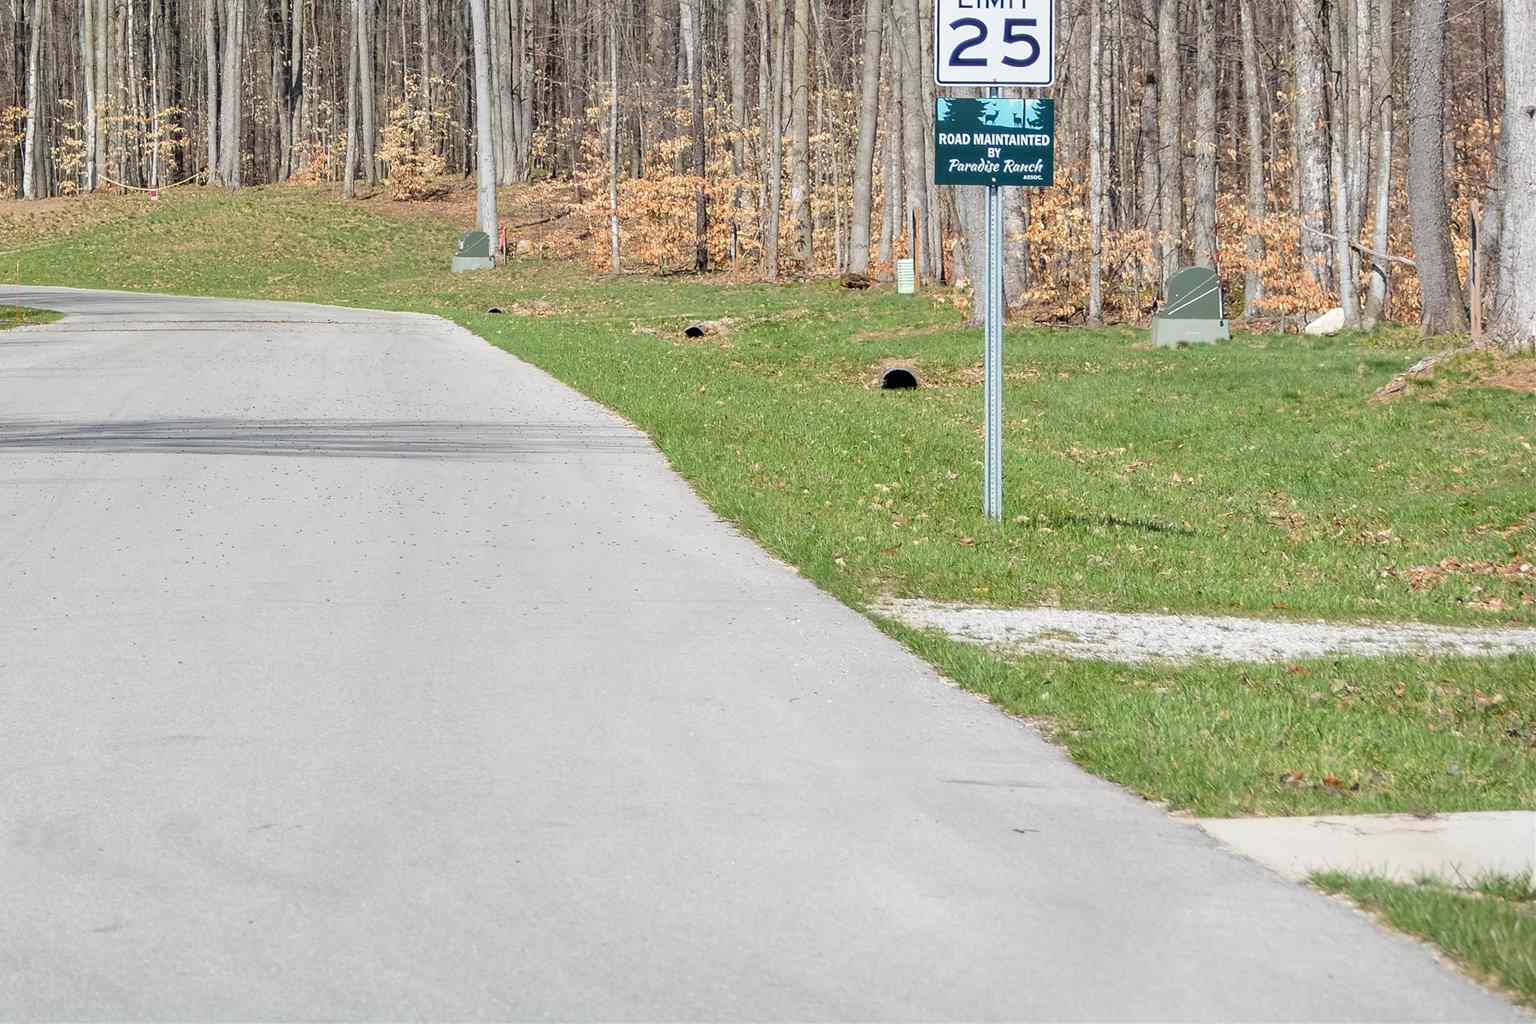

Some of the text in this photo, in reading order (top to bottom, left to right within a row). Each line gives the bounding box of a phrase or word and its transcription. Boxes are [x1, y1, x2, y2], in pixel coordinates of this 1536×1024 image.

[948, 17, 1041, 68] 25
[938, 133, 1051, 146] ROAD MAINTAINTED
[987, 148, 1002, 158] BY
[948, 158, 1043, 173] Paradise Ranch
